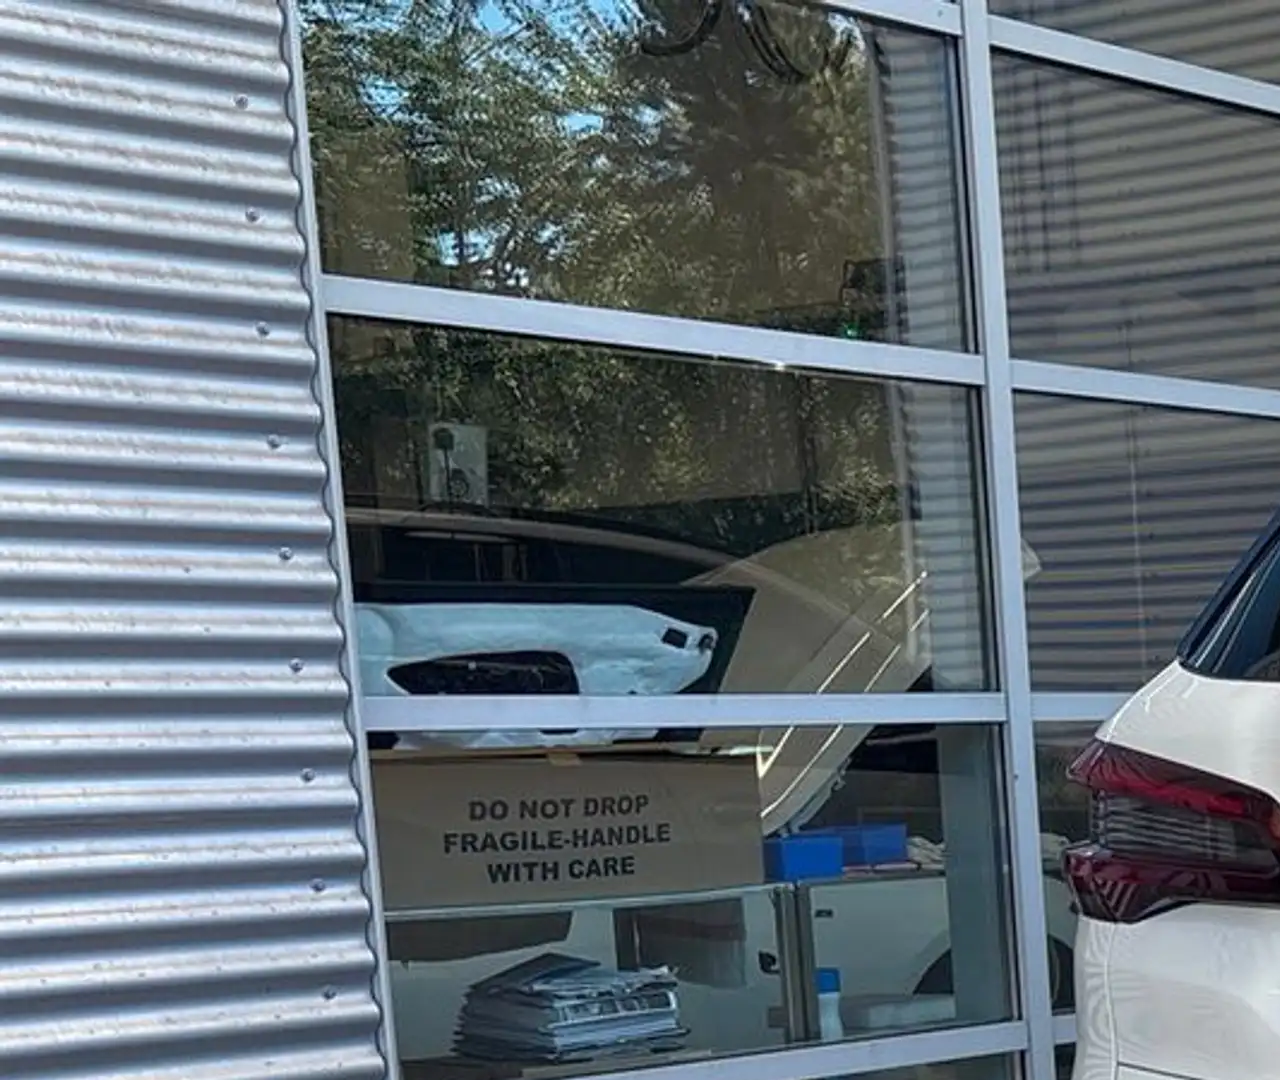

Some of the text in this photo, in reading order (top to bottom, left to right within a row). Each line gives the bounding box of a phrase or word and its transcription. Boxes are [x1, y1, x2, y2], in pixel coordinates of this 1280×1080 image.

[469, 794, 649, 821] DO NOT DROP
[443, 823, 671, 854] FRAGILE-HANDLE
[487, 855, 635, 883] WITH CARE
